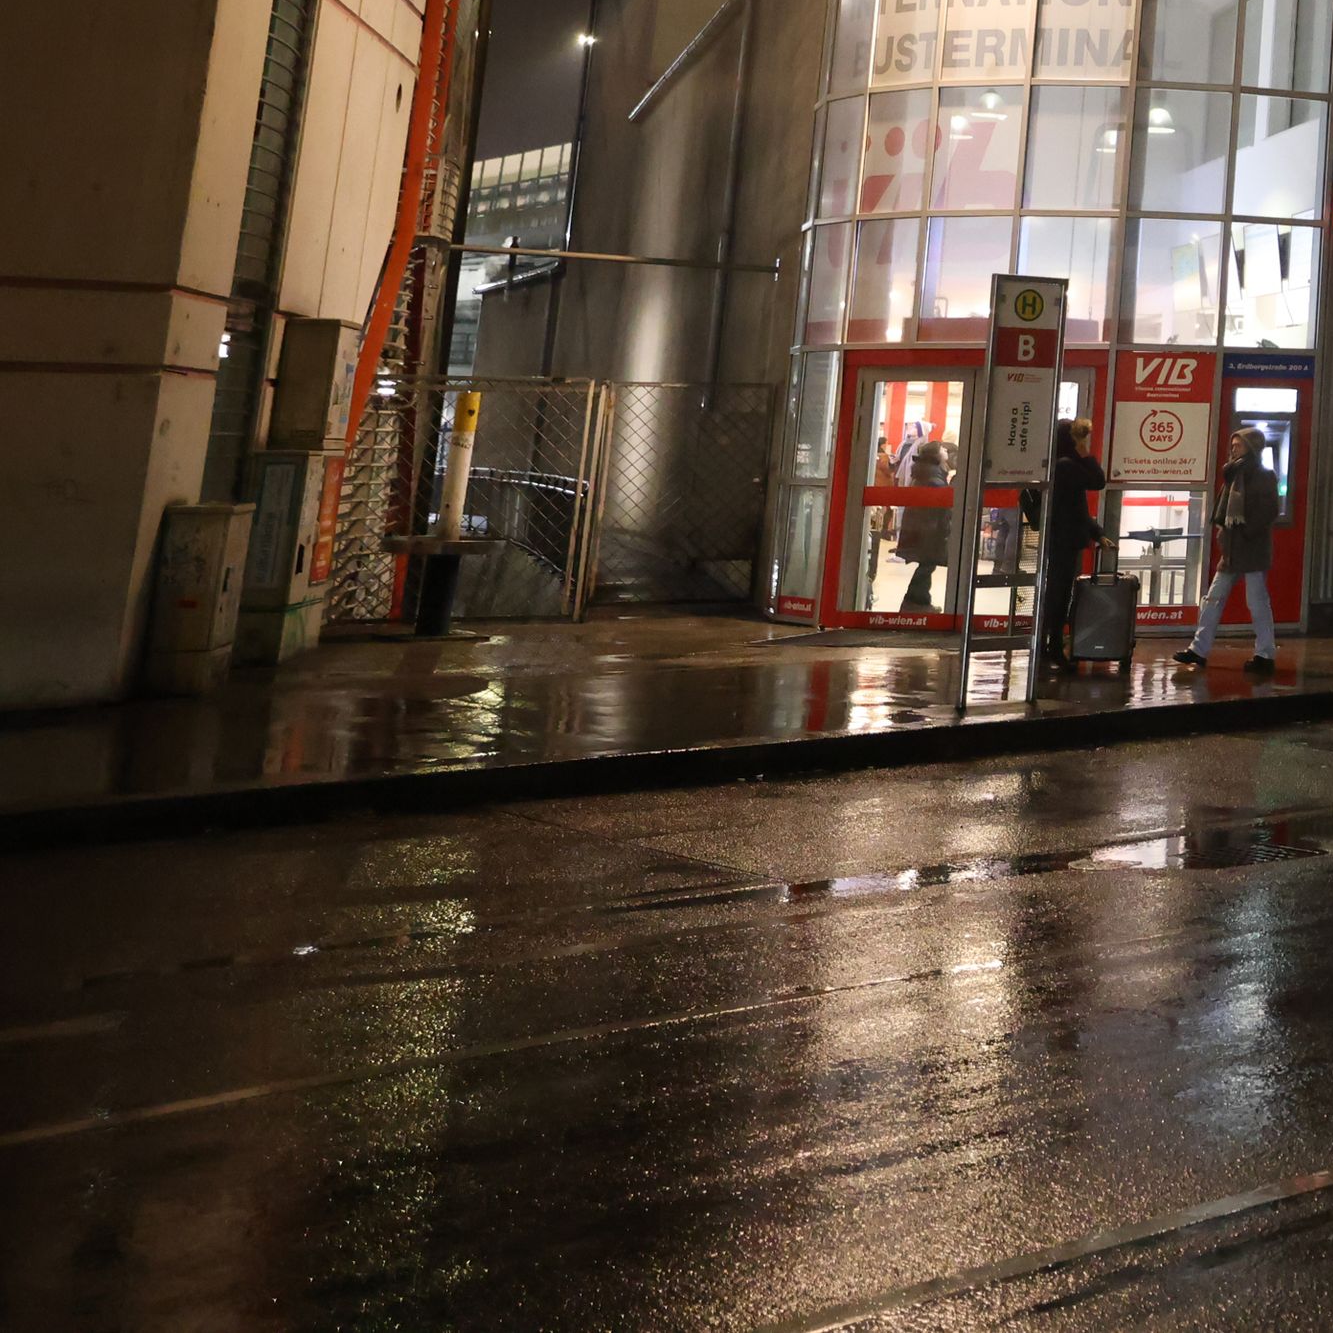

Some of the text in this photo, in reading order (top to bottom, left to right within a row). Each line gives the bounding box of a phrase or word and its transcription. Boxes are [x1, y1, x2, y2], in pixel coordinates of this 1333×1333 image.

[1021, 294, 1037, 315] H
[1017, 334, 1035, 362] B
[1135, 357, 1198, 385] VIB
[1008, 407, 1019, 446] Have a
[1020, 401, 1032, 453] safe trip!
[1149, 422, 1174, 433] 365
[1123, 457, 1151, 465] Tickets
[1152, 457, 1177, 465] online
[1124, 468, 1192, 476] www.vib-wien.at
[868, 616, 928, 627] vib-wien.at
